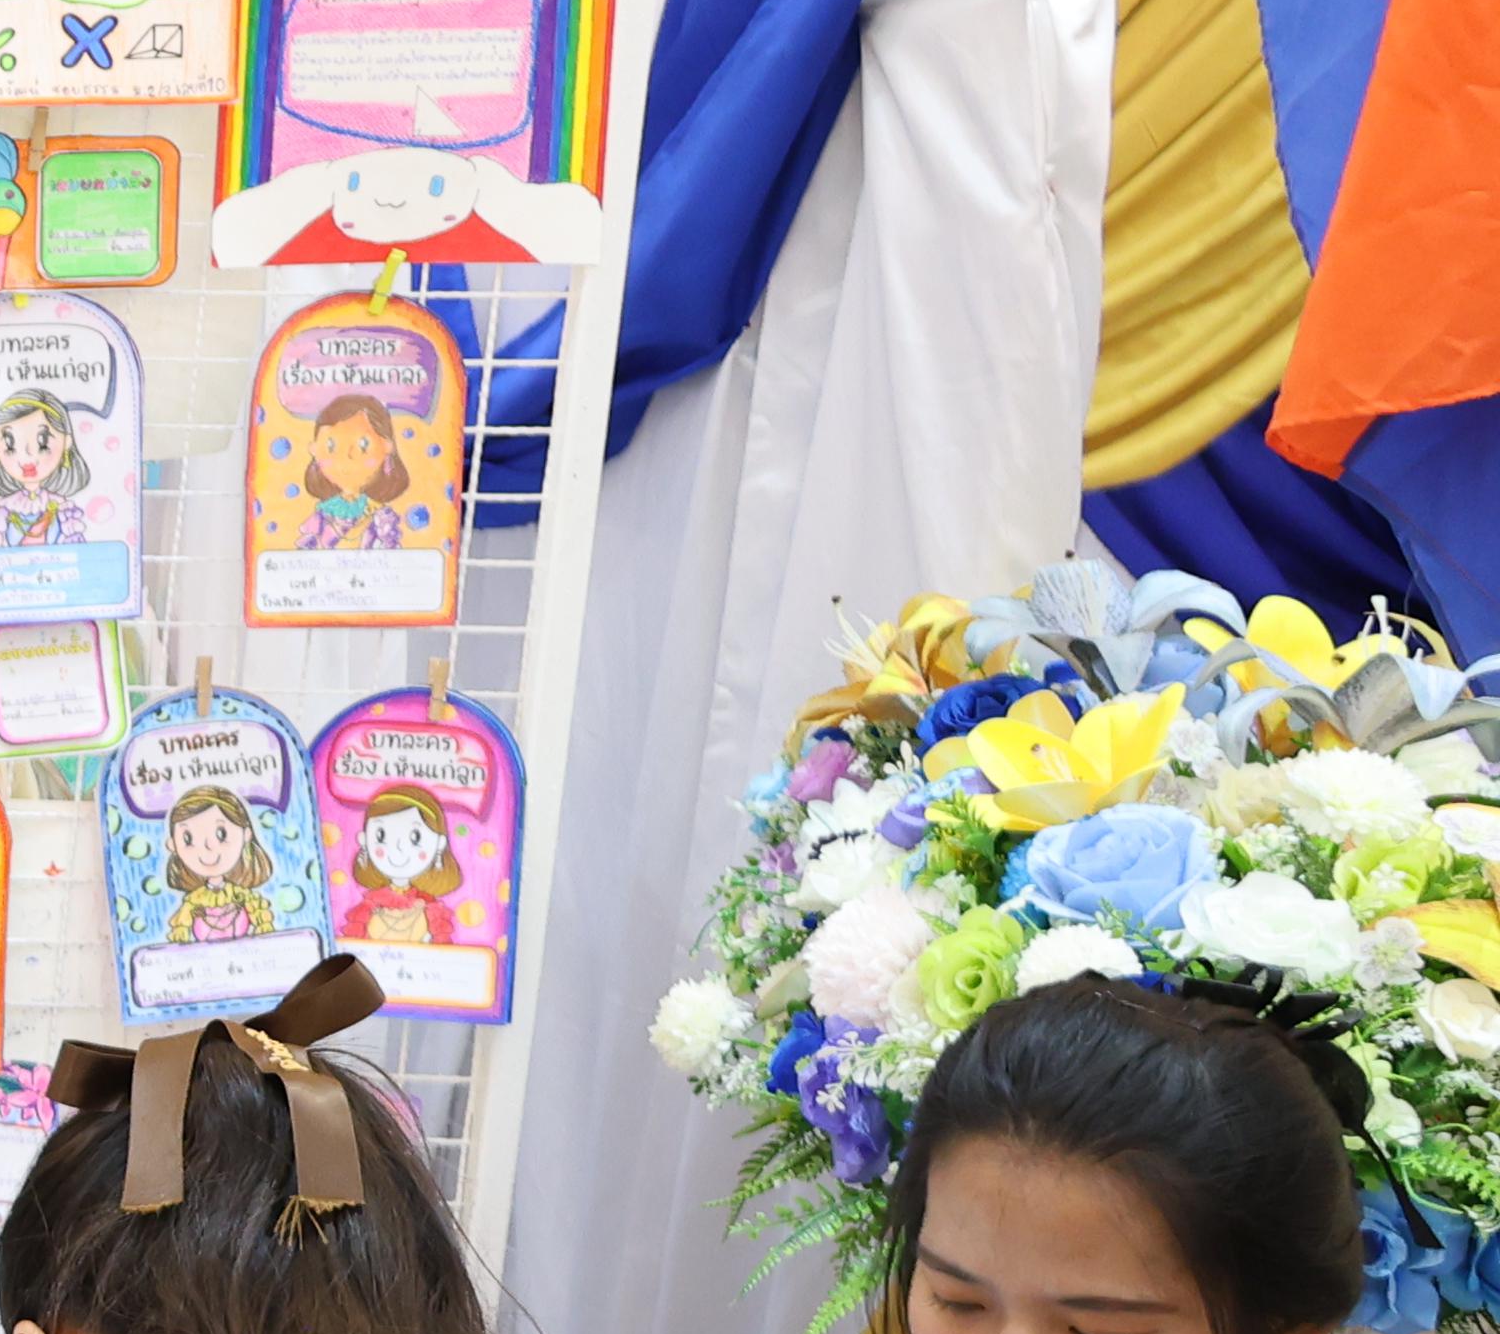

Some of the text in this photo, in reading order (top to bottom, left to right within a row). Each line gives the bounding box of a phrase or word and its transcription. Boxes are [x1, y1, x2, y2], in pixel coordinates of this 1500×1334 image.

[317, 338, 396, 356] บทละคร
[160, 732, 241, 756] บทละคร
[369, 730, 453, 751] บทละคร
